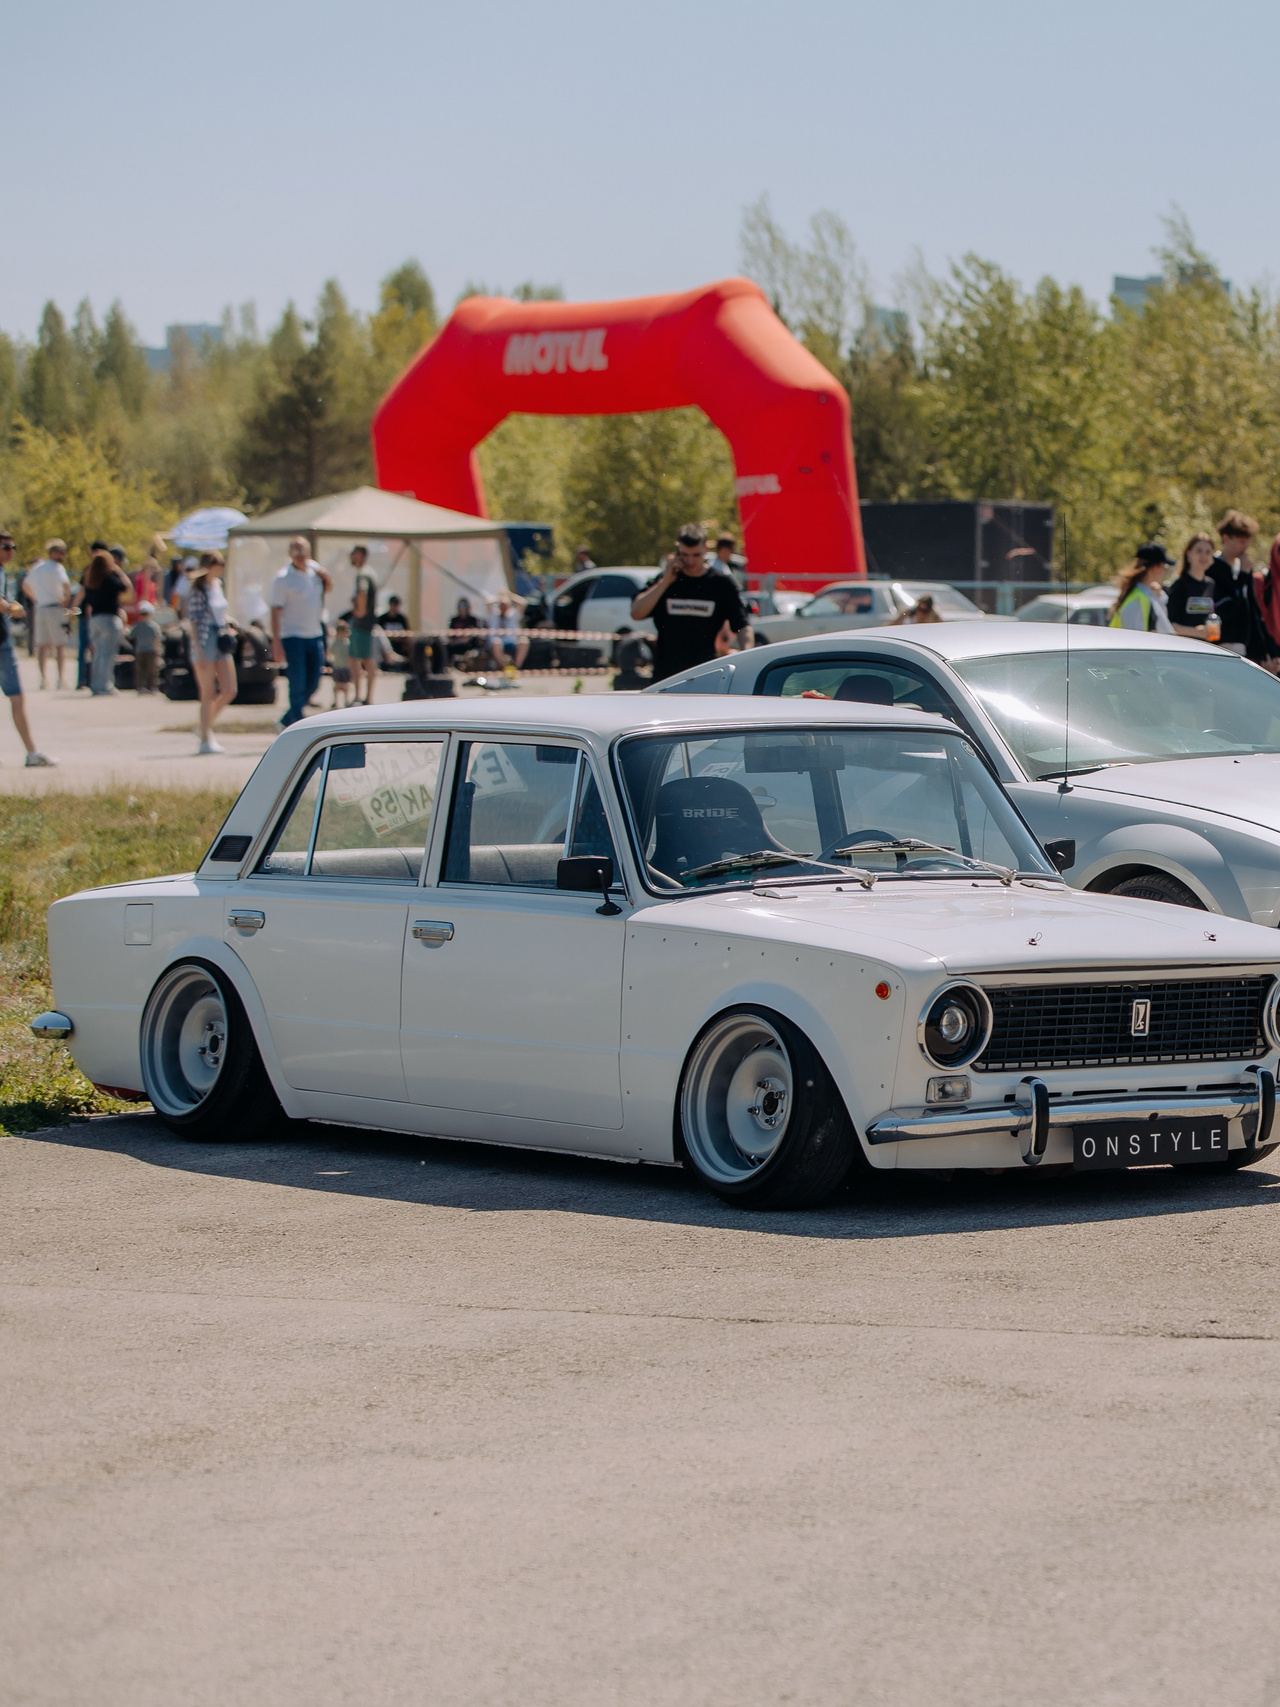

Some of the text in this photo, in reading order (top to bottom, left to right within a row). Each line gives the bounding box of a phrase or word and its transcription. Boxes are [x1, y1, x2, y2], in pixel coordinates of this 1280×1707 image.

[502, 328, 609, 375] MOTUL
[682, 807, 739, 818] BRIDE
[1082, 1129, 1221, 1158] ONSTYLE
